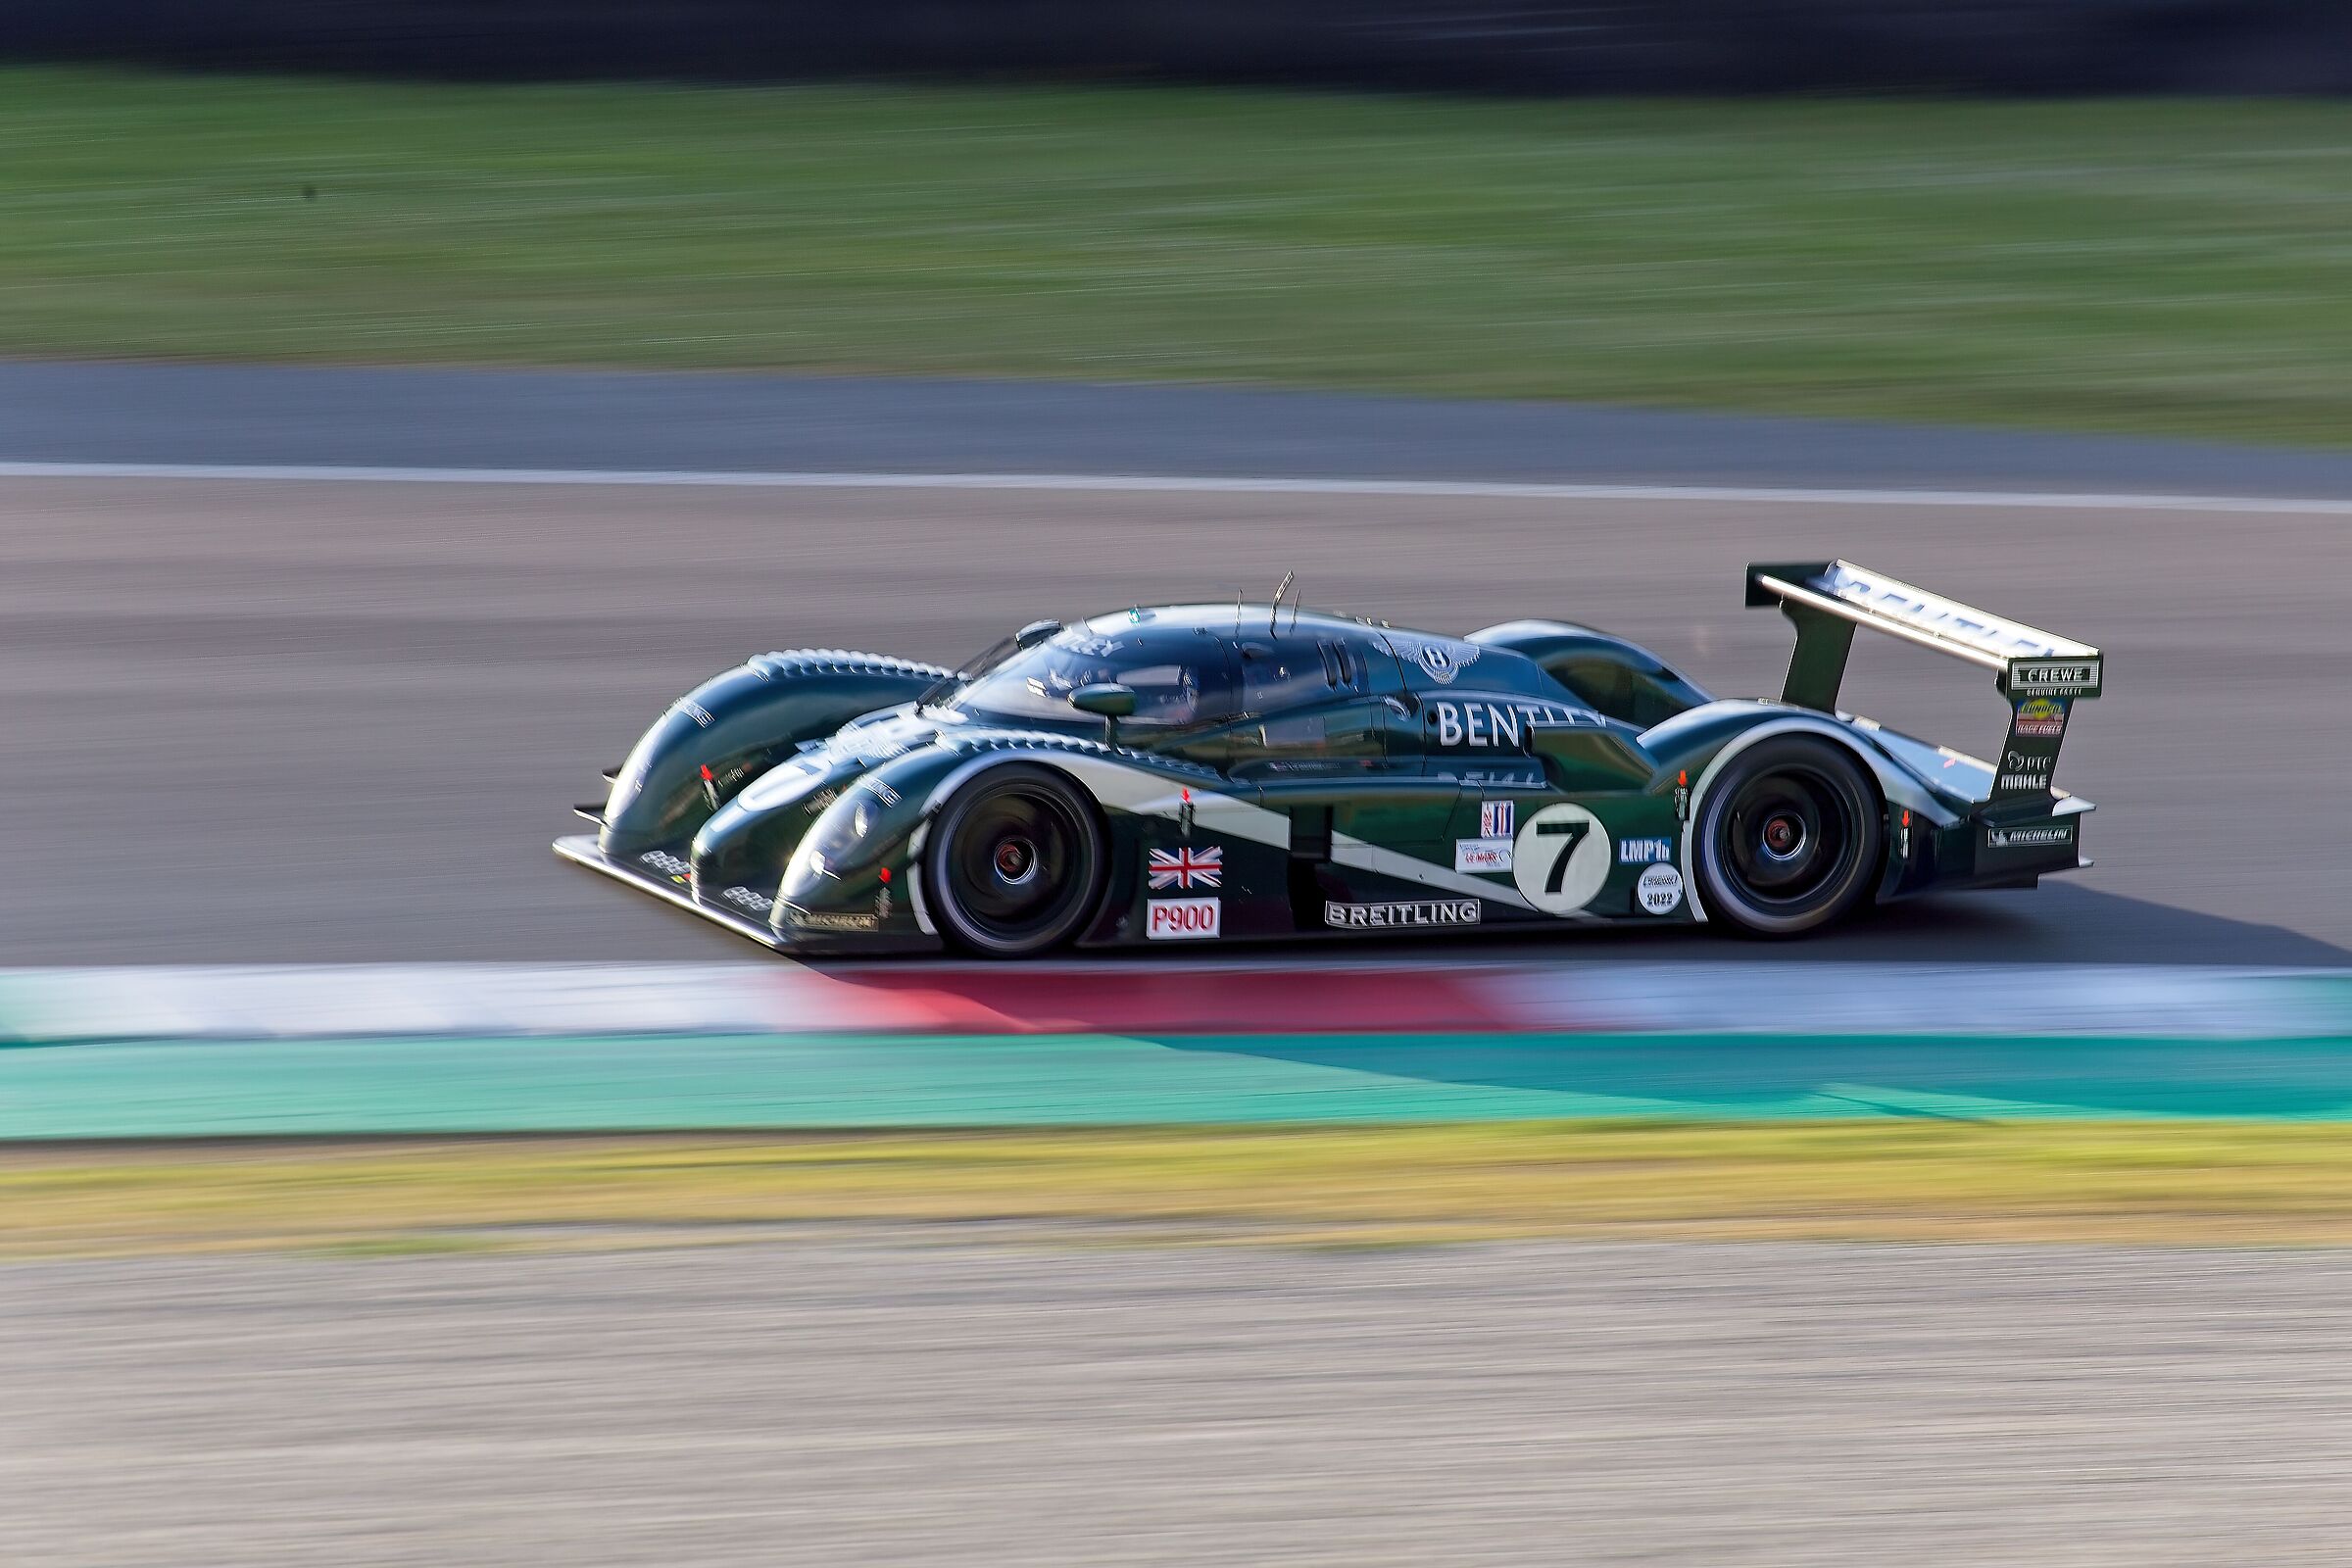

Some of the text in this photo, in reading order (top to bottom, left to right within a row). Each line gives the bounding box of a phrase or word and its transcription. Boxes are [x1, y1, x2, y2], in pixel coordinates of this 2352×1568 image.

[2028, 667, 2083, 682] CREWE
[2001, 774, 2047, 790] MAHLE
[2009, 828, 2069, 842] MICHELIN
[1536, 821, 1590, 893] 7
[1647, 893, 1673, 906] 2022
[1152, 904, 1214, 932] P900
[1328, 902, 1478, 928] BREITLING
